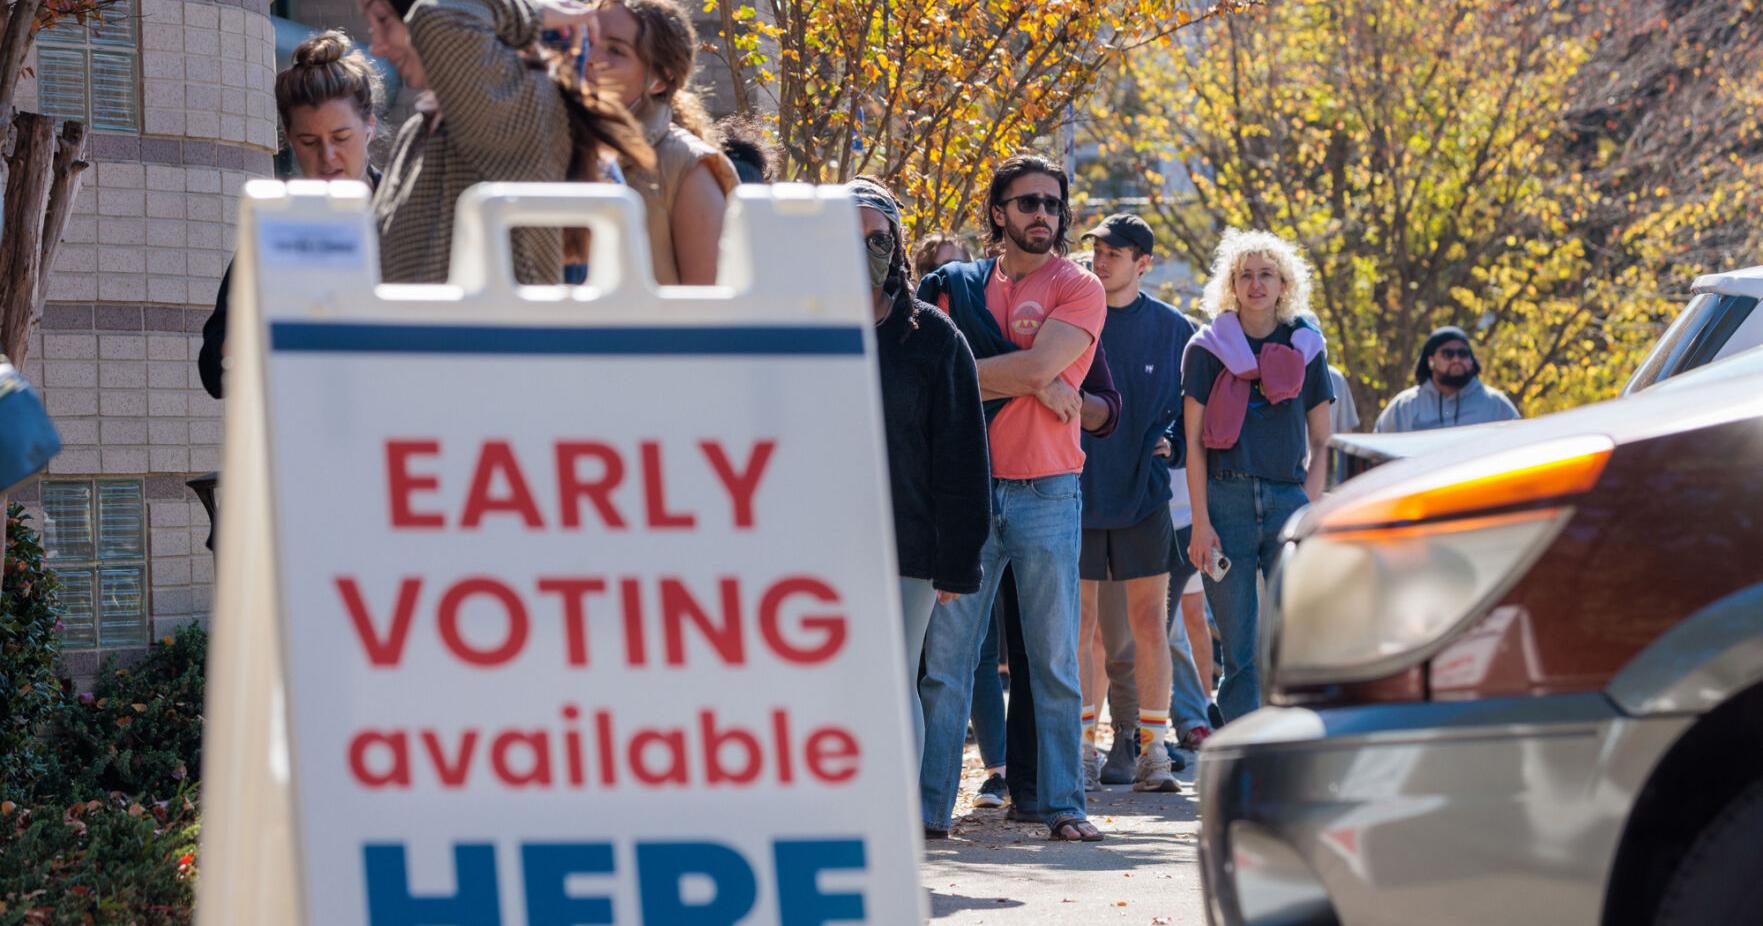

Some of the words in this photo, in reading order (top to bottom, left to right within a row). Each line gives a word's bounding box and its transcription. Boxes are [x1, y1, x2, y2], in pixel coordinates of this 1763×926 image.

[384, 438, 777, 530] EARLY
[335, 575, 849, 668] VOTING
[347, 704, 862, 790] available
[361, 838, 868, 926] HERE
